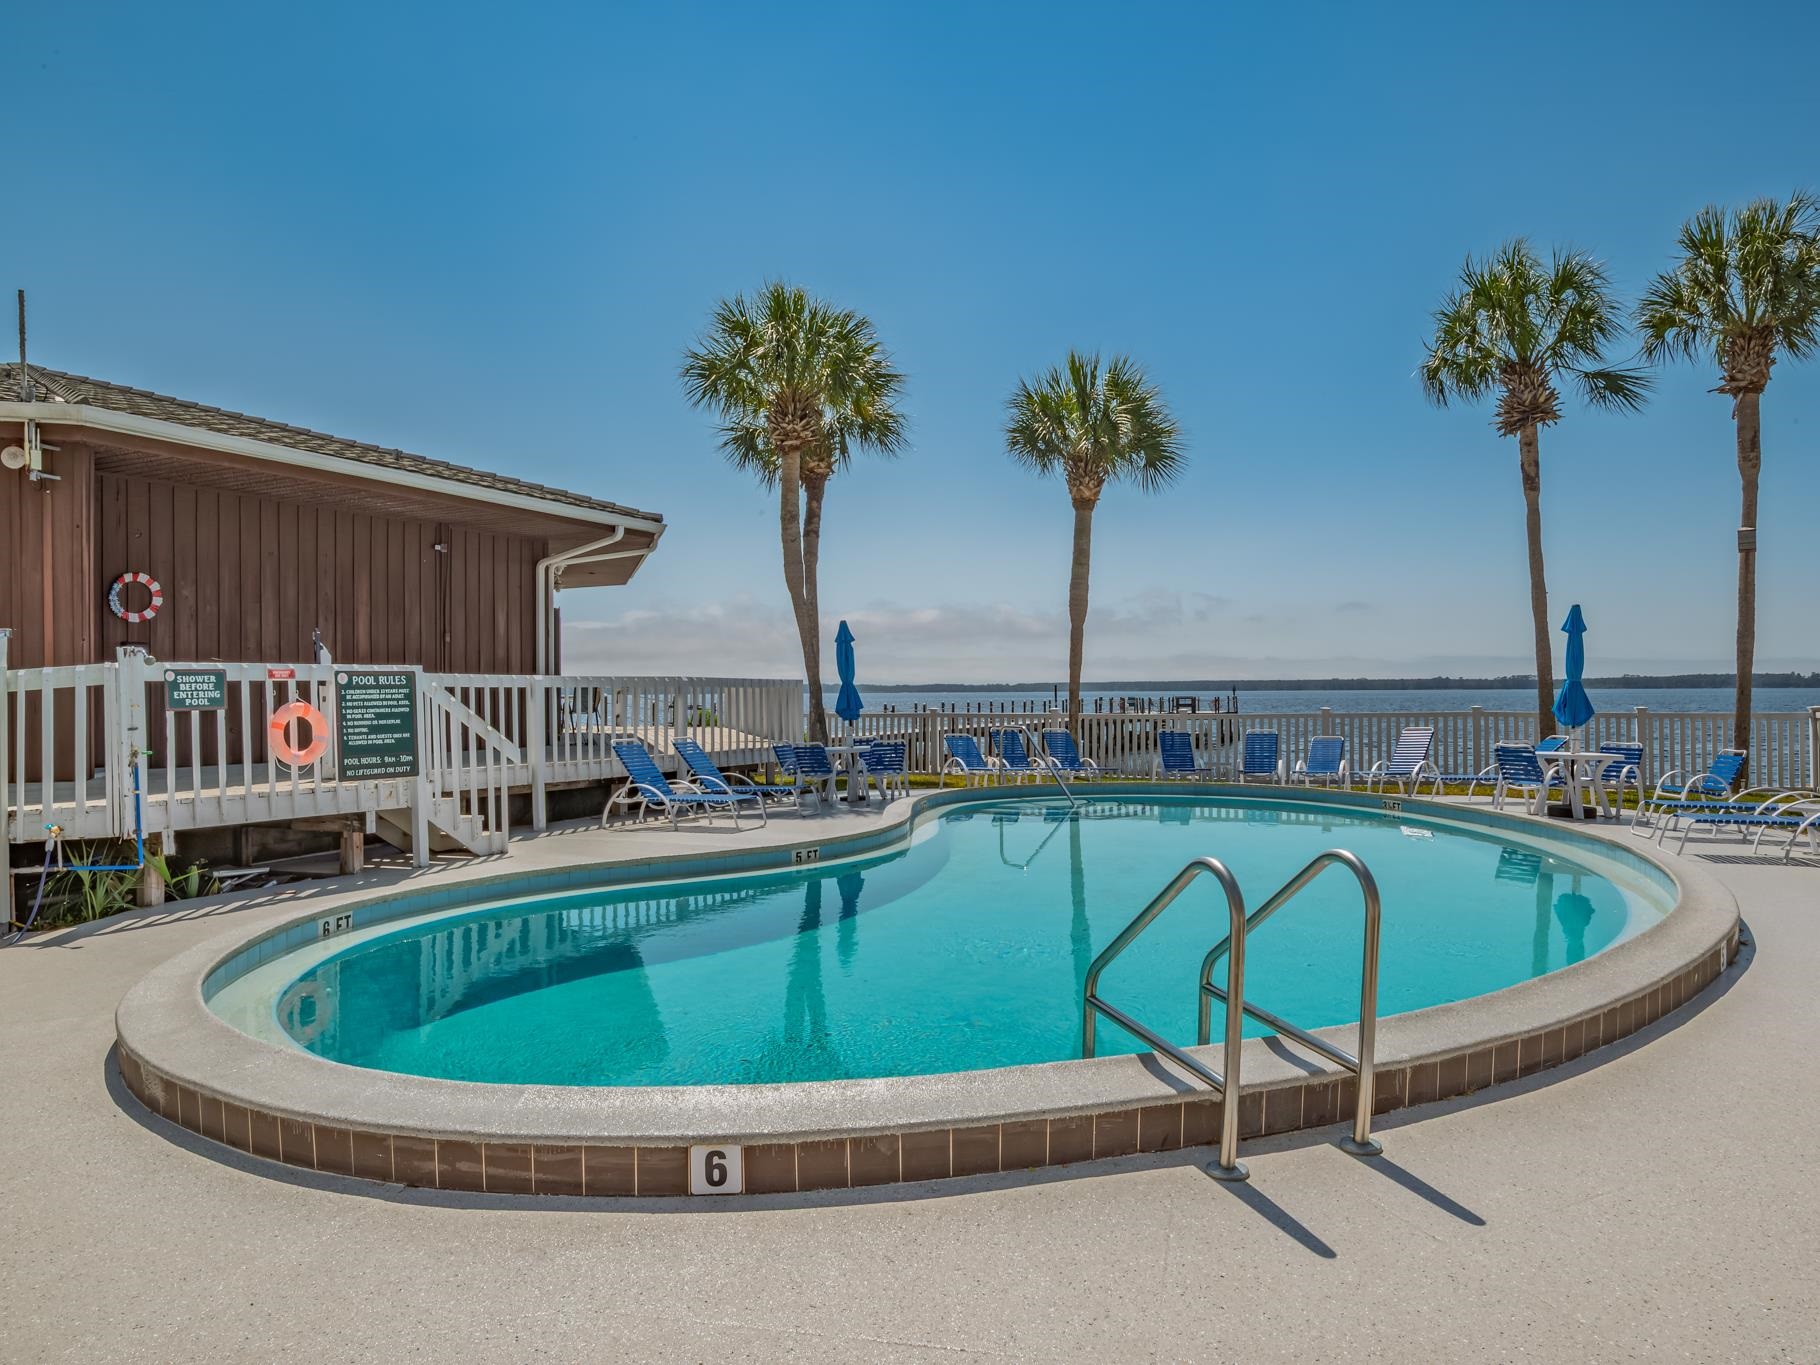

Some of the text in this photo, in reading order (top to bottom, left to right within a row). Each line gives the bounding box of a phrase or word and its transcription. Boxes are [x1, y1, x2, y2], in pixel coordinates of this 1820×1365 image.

[352, 676, 406, 685] POOL RULES
[174, 690, 220, 698] ENTERING
[796, 849, 818, 863] 5 FT
[323, 914, 351, 937] 6 FT
[705, 1150, 727, 1187] 6
